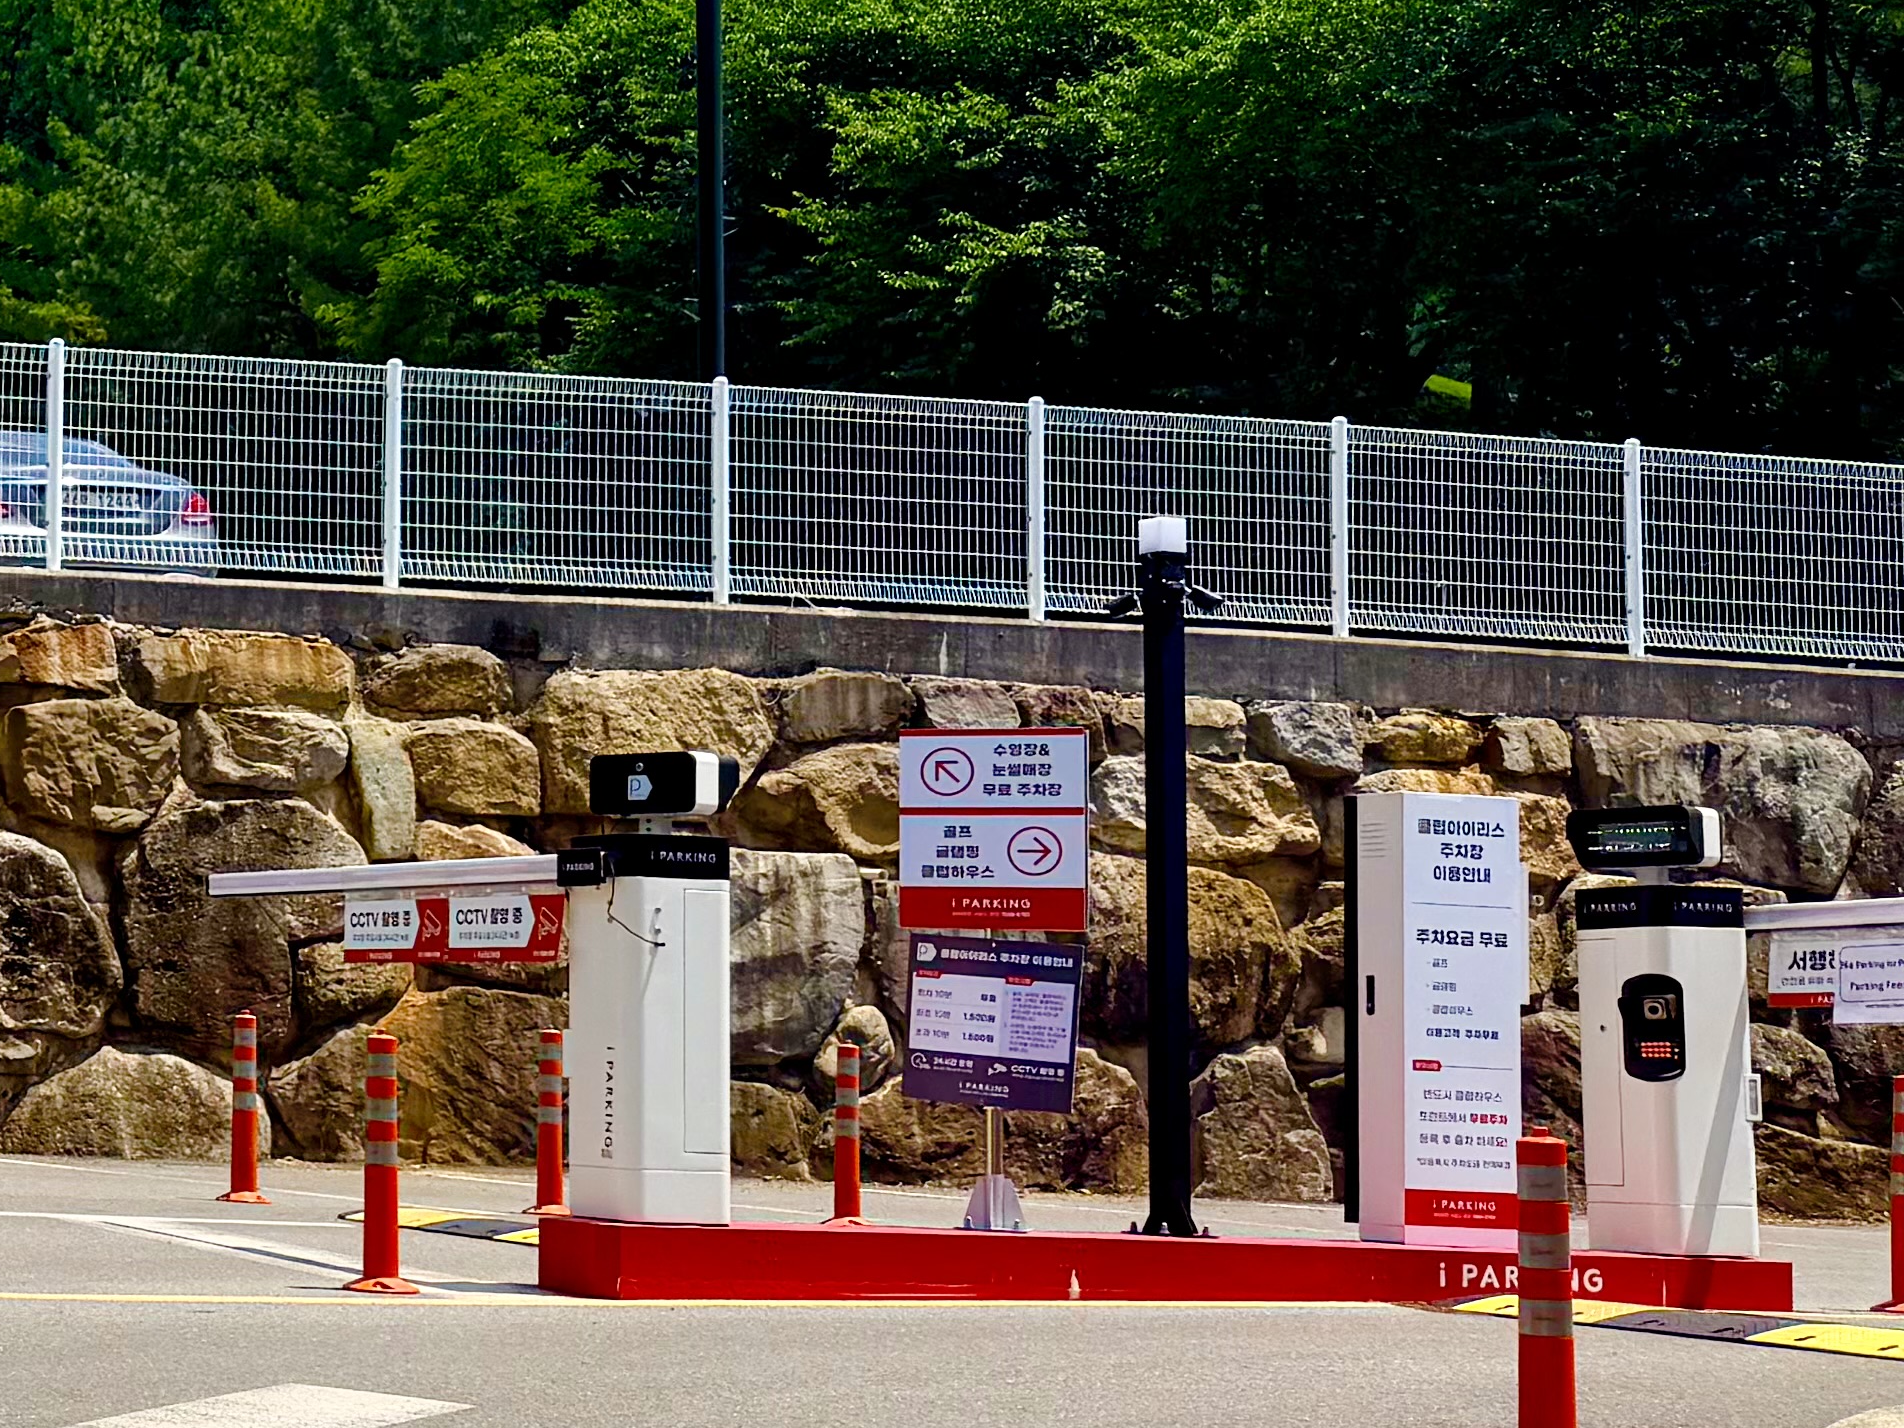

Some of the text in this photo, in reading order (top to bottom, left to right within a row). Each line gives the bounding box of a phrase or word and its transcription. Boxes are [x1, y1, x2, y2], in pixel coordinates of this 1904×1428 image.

[993, 743, 1050, 757] 수영장&
[983, 783, 1062, 797] 무료 주차장
[659, 851, 717, 864] PARKING
[1440, 842, 1483, 860] 주차장
[1433, 865, 1491, 883] 이용안내
[962, 898, 1031, 909] PARKING
[350, 912, 379, 928] CCTV
[456, 908, 488, 925] CCTV
[1416, 928, 1508, 948] 주차요금 무료
[604, 1061, 614, 1148] PARKING
[1442, 1200, 1496, 1211] PARKING
[1440, 1262, 1603, 1293] i PARG
